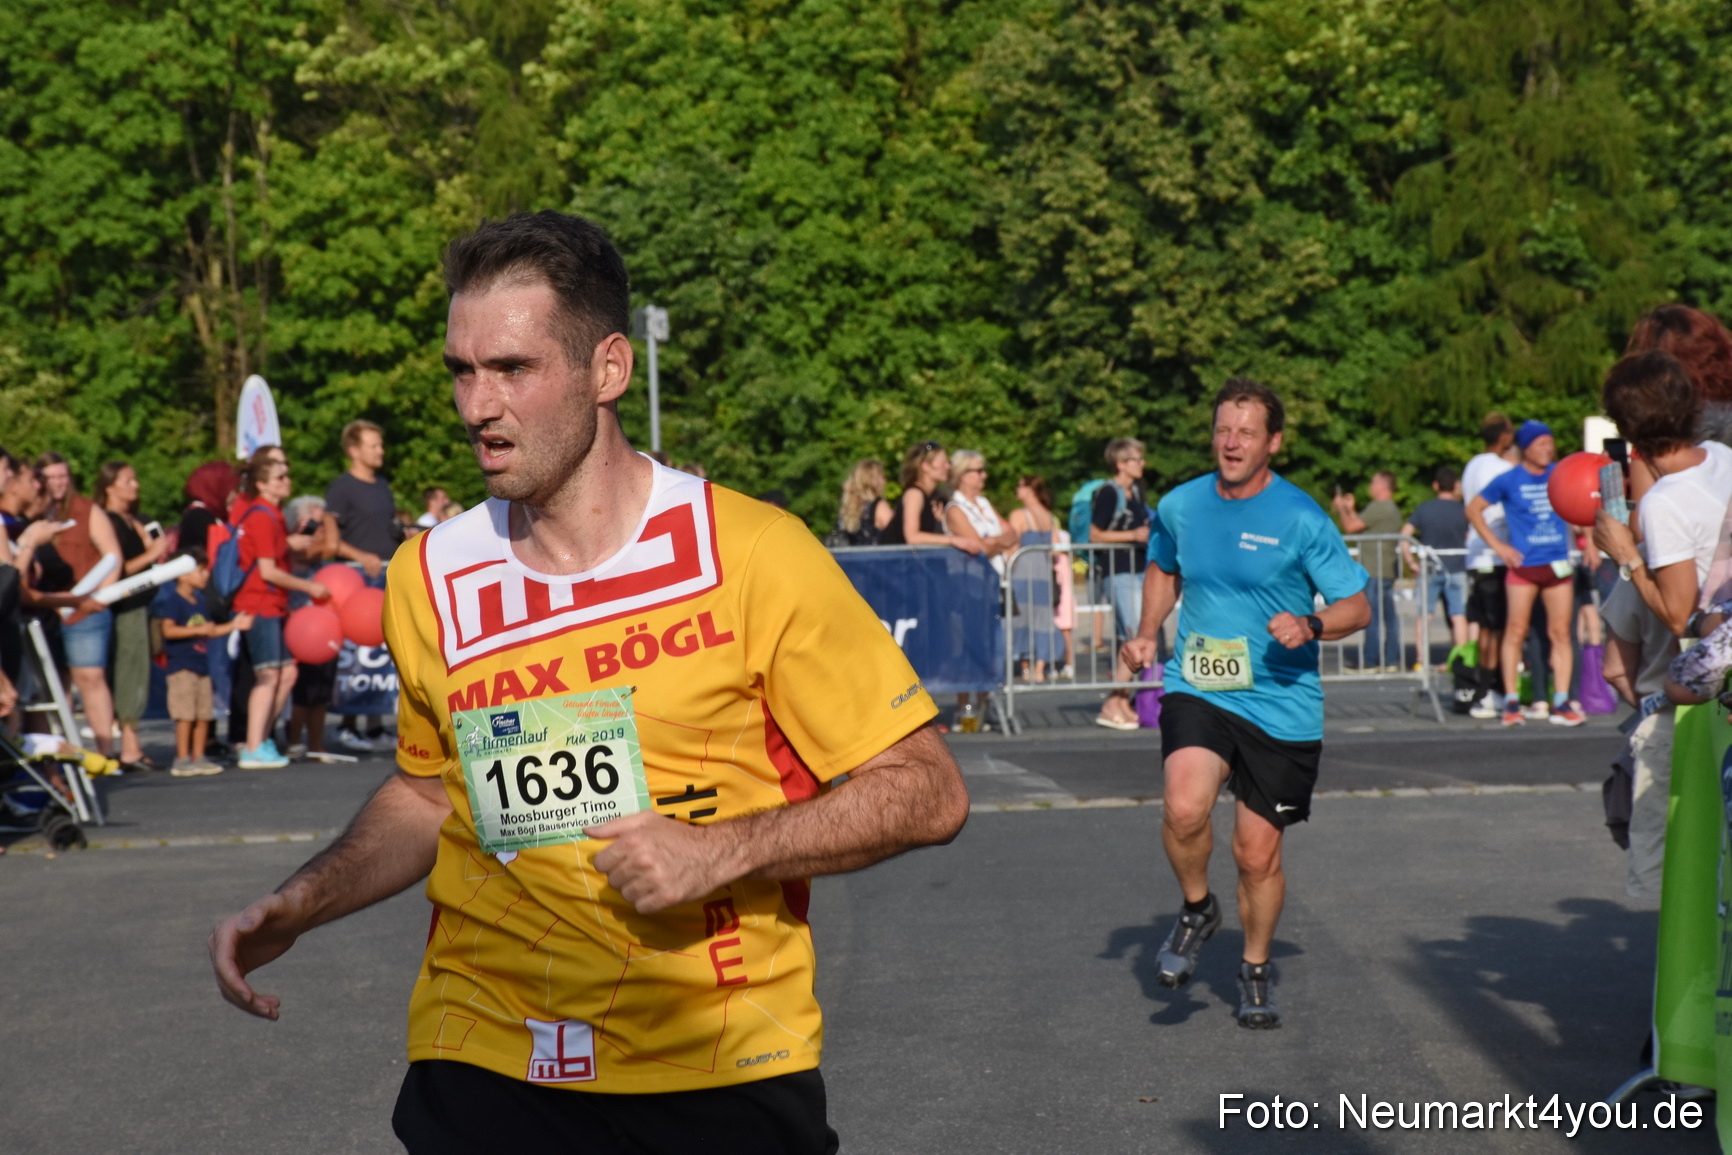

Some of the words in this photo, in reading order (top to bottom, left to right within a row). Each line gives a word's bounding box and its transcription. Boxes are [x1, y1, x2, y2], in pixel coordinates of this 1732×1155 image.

[447, 657, 569, 713] MAX
[584, 611, 735, 683] BÖGL
[1189, 654, 1240, 676] 1860
[482, 726, 548, 751] firmenlauf
[565, 733, 587, 747] run
[591, 727, 625, 742] 2019
[486, 745, 619, 809] 1636
[500, 806, 577, 826] Moosburger
[580, 800, 616, 814] Timo
[500, 827, 515, 837] Max
[517, 822, 537, 836] Bögl
[538, 819, 589, 833] Bauservice
[591, 812, 621, 825] GmbH
